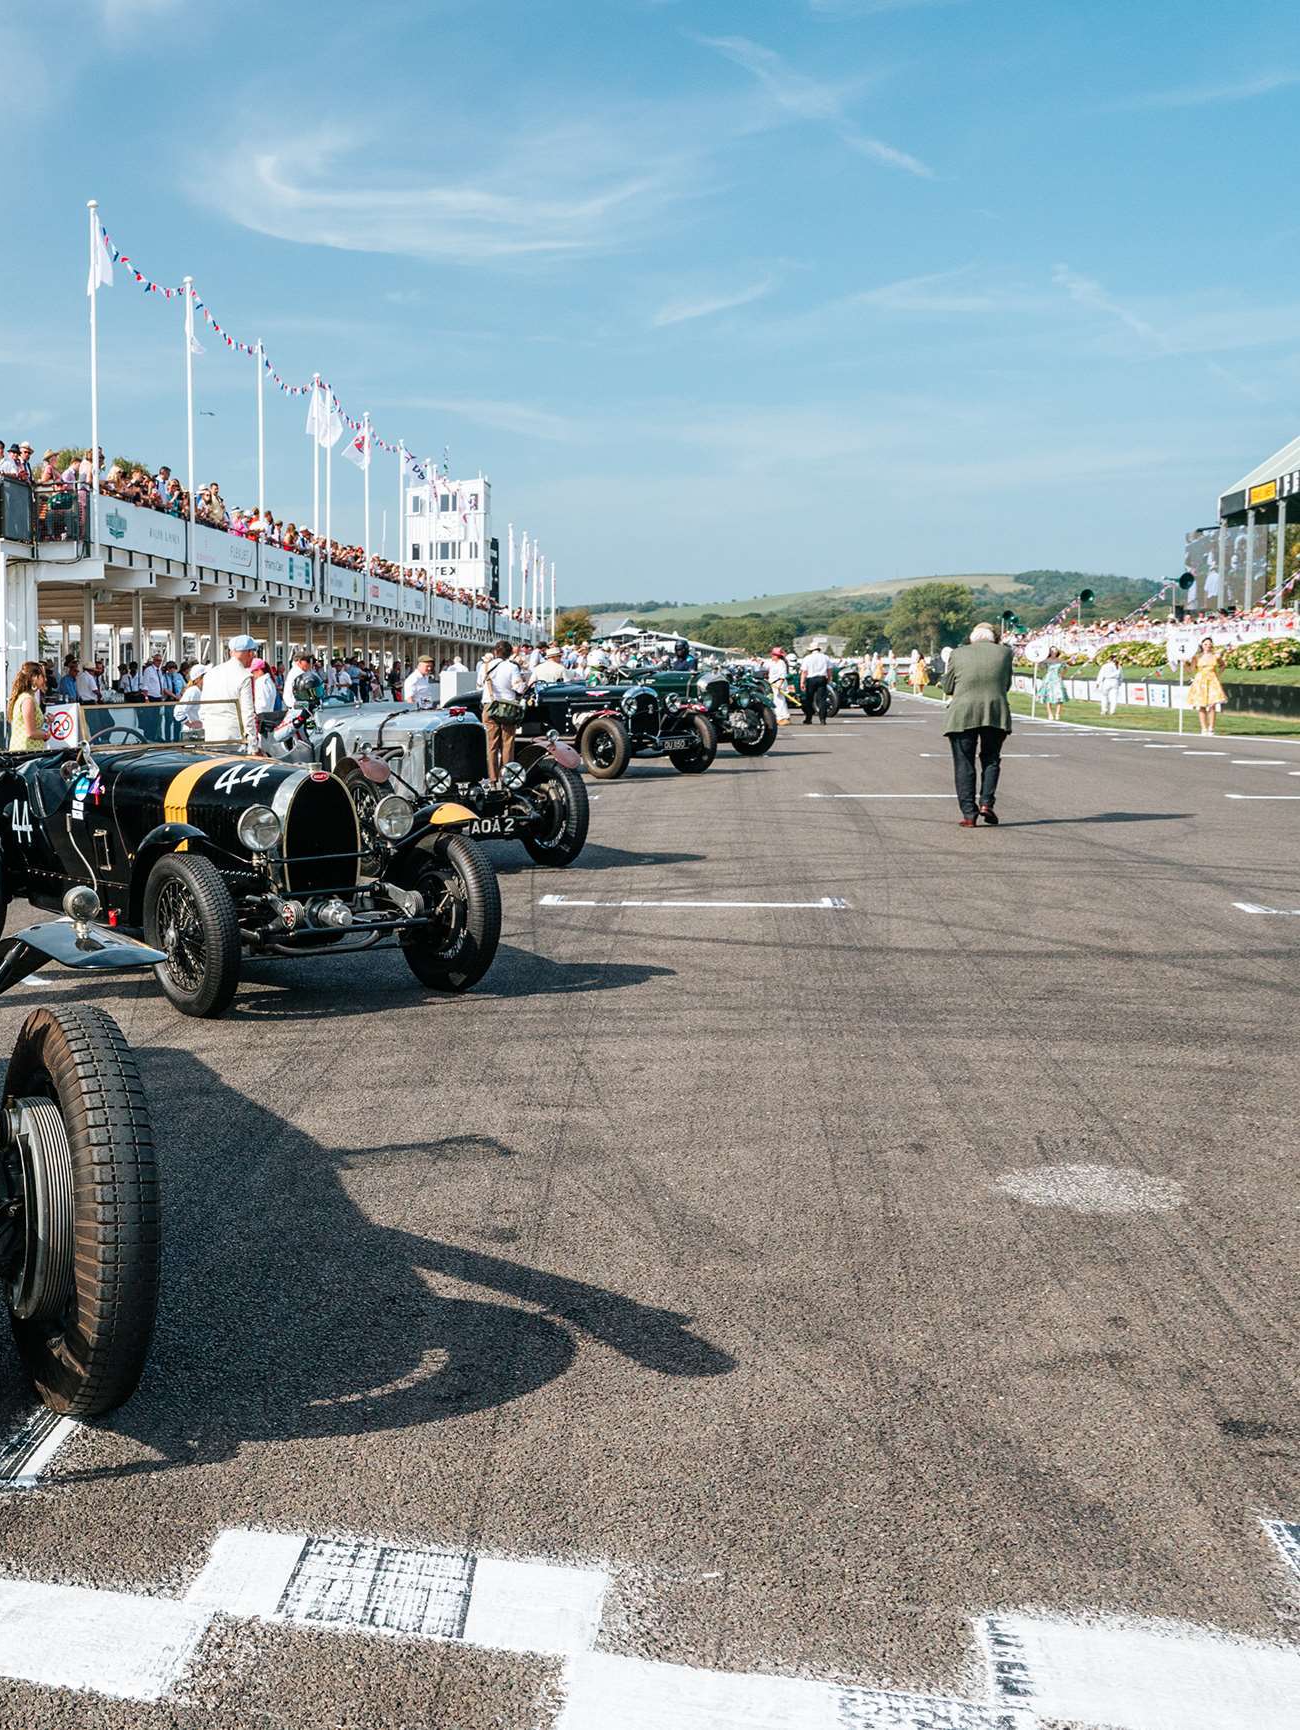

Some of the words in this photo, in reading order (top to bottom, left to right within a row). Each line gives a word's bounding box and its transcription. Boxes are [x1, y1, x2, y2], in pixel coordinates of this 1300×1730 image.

[190, 581, 198, 592] 2
[228, 589, 235, 599] 3
[260, 594, 267, 604] 4
[289, 600, 295, 609] 5
[314, 605, 320, 614] 6
[365, 614, 372, 622] 8
[53, 720, 70, 732] 20
[325, 736, 337, 774] 1
[214, 764, 274, 795] 44
[12, 799, 33, 843] 44
[471, 818, 501, 834] AOA
[504, 818, 514, 832] 2
